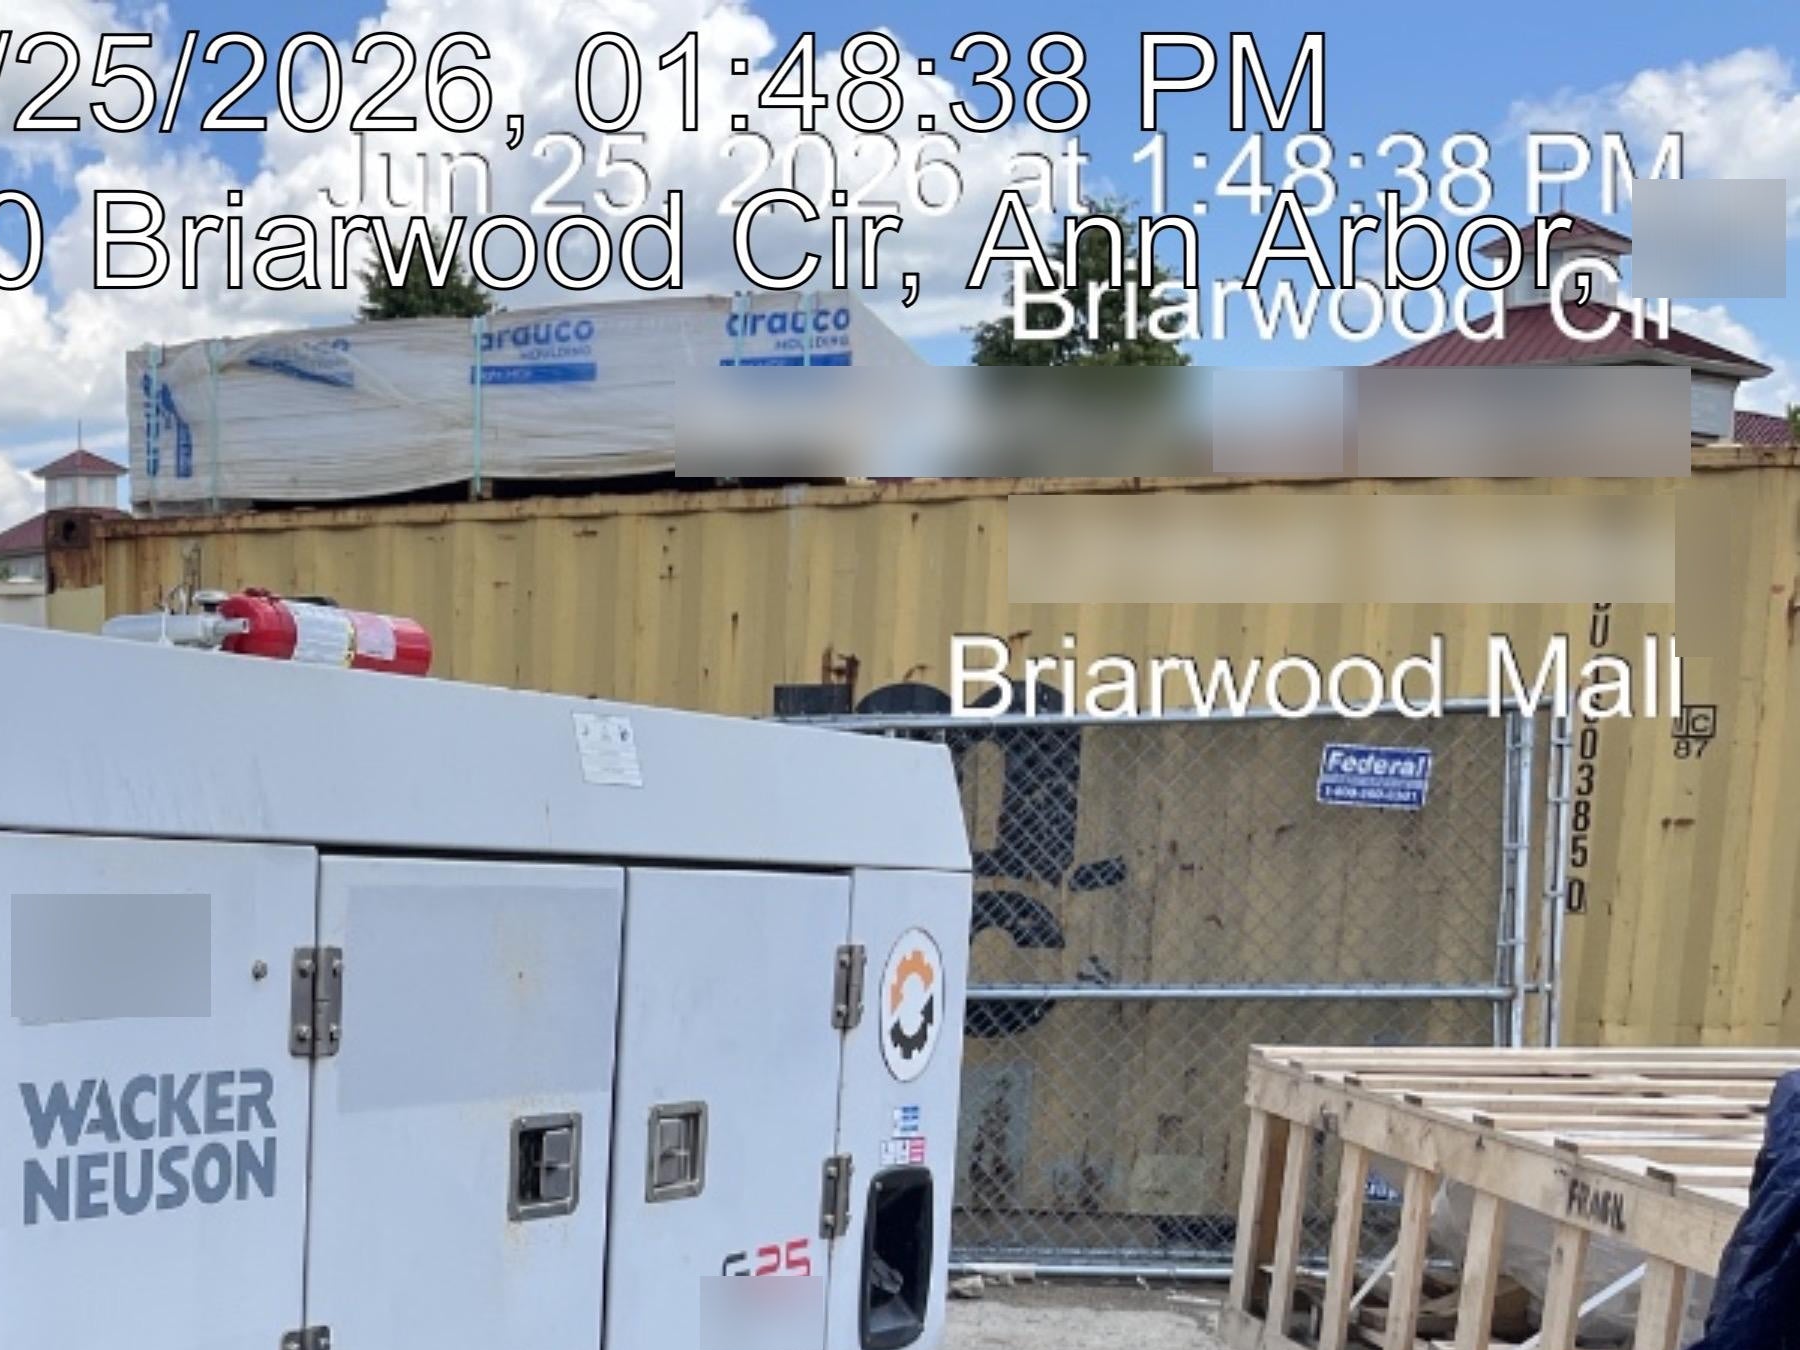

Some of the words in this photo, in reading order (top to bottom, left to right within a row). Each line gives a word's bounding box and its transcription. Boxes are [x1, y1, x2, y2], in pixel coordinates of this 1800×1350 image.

[1328, 750, 1426, 777] Federal
[18, 1067, 277, 1149] WACKER
[22, 1135, 277, 1226] NEUSON
